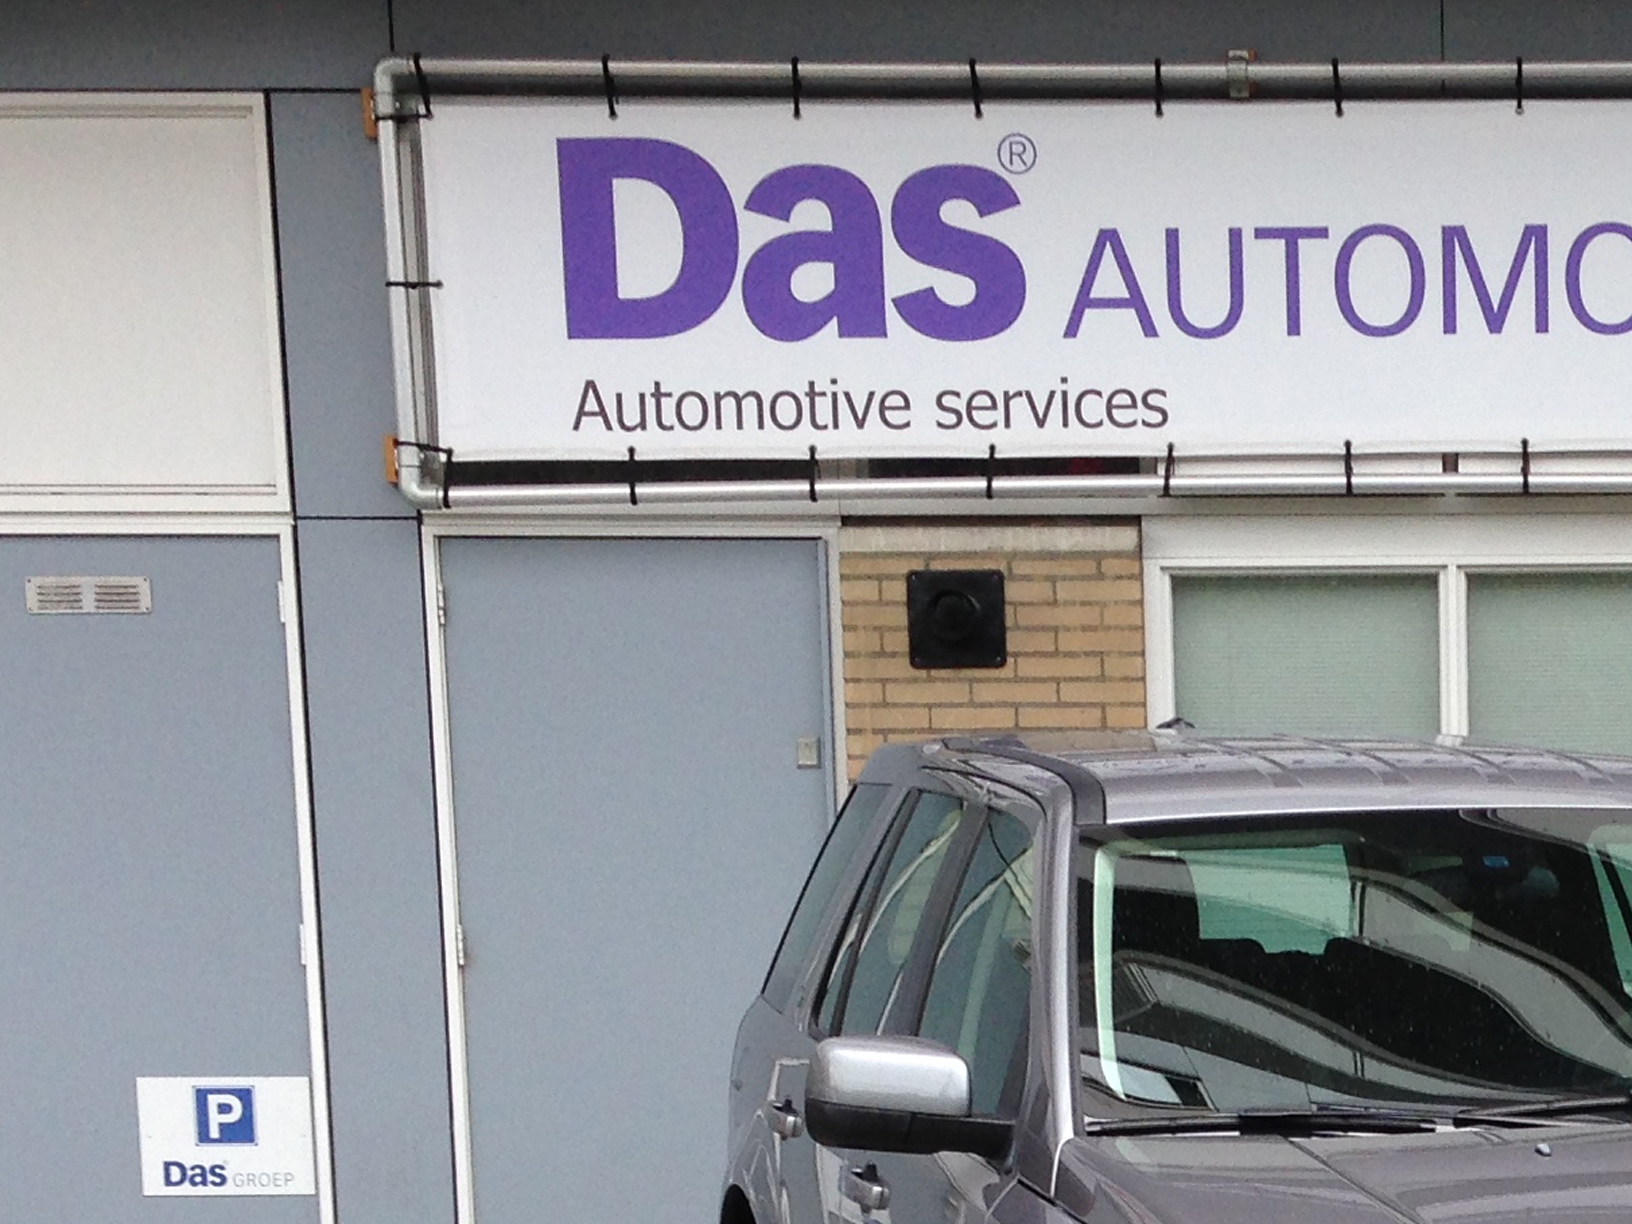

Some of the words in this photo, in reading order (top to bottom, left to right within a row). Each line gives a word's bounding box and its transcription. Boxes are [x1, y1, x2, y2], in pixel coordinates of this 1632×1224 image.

[556, 136, 1027, 342] Das
[572, 378, 912, 433] Automotive
[934, 376, 1170, 431] services
[206, 1093, 244, 1140] P
[162, 1160, 228, 1188] Das
[232, 1172, 295, 1188] GROEP
